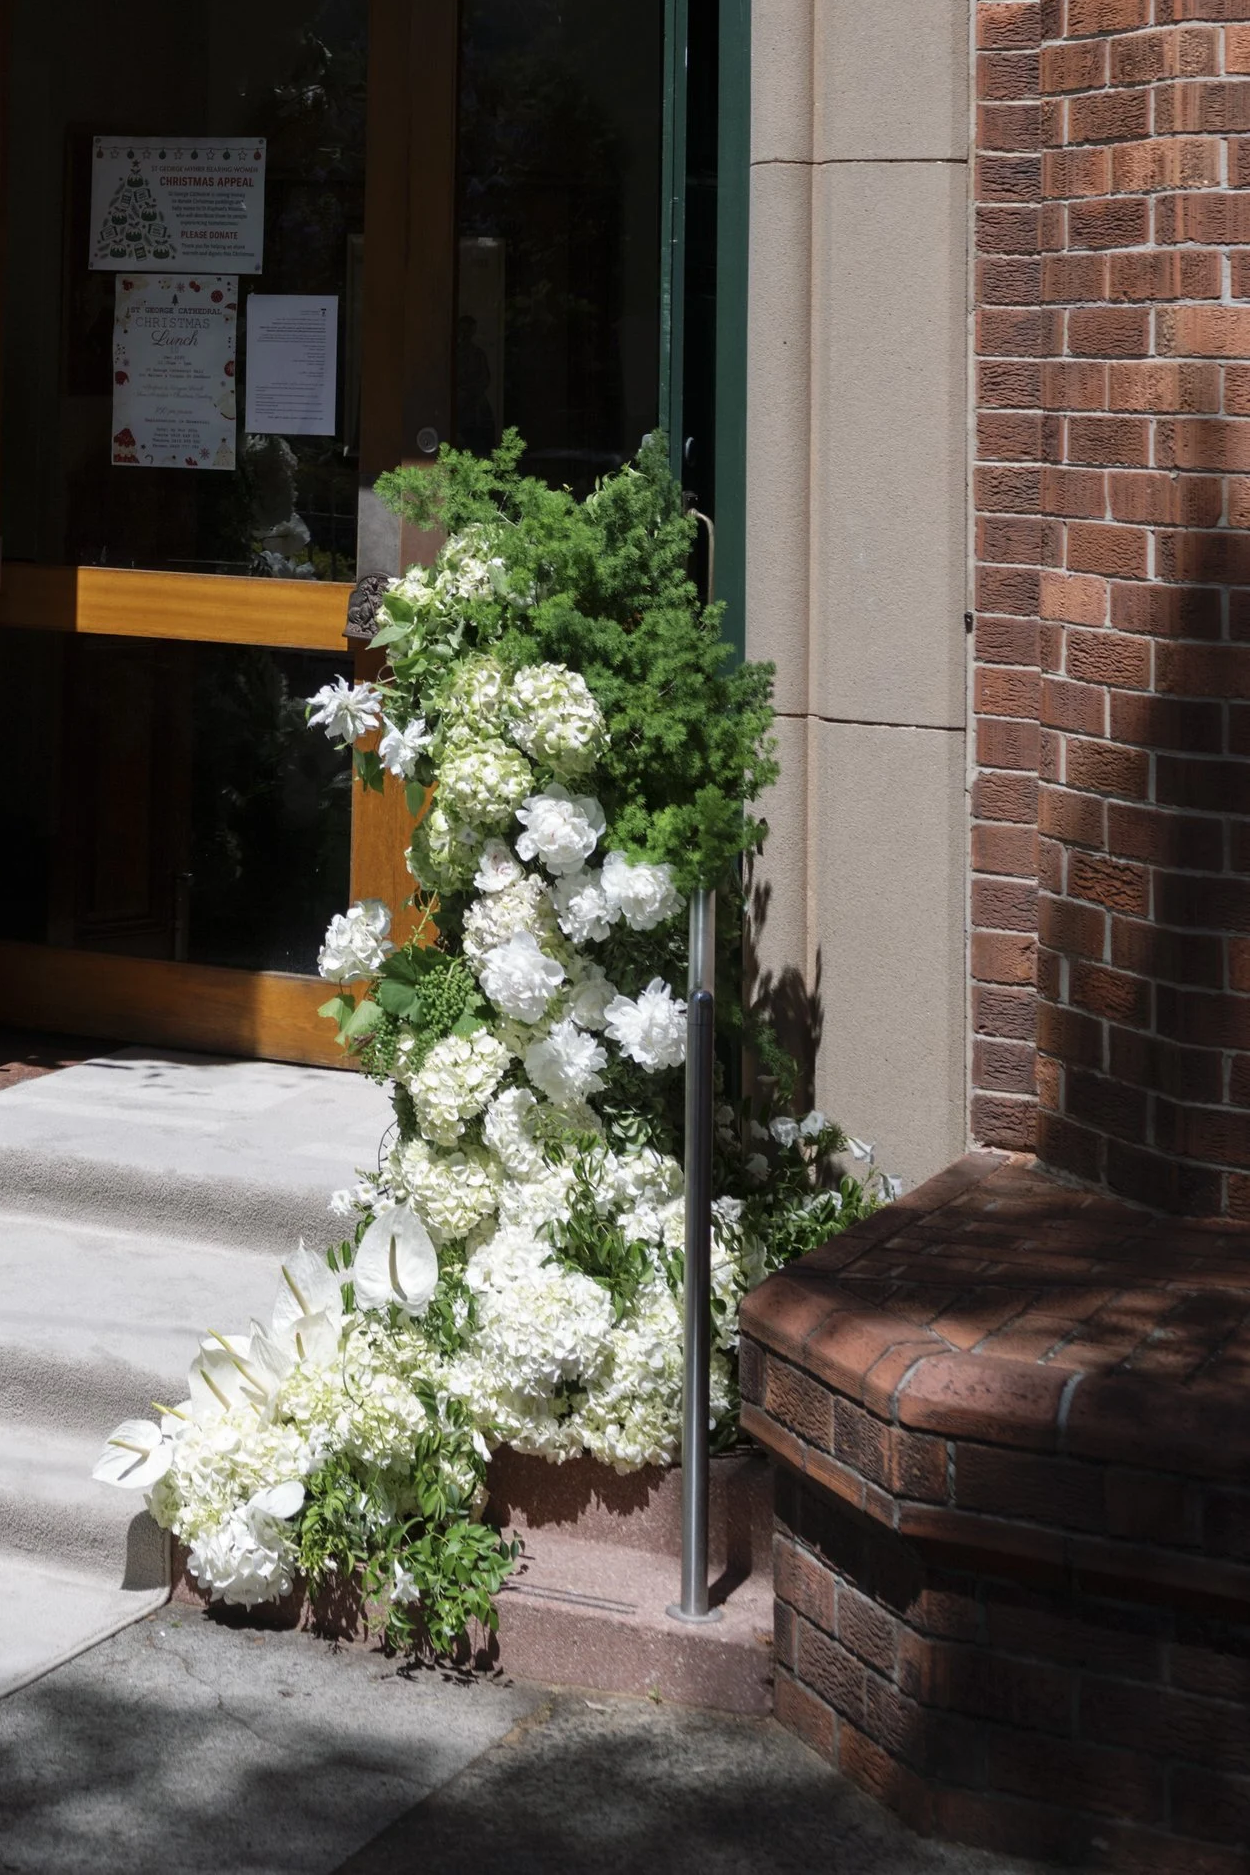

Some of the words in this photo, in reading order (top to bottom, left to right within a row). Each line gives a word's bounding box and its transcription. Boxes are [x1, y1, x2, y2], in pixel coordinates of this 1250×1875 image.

[159, 176, 215, 187] CHRISTMAS
[217, 177, 254, 187] APPEAL
[181, 230, 207, 239] PLEASE
[209, 231, 238, 240] DONATE
[135, 316, 210, 329] CHRISTMAS
[151, 330, 198, 347] Lunch
